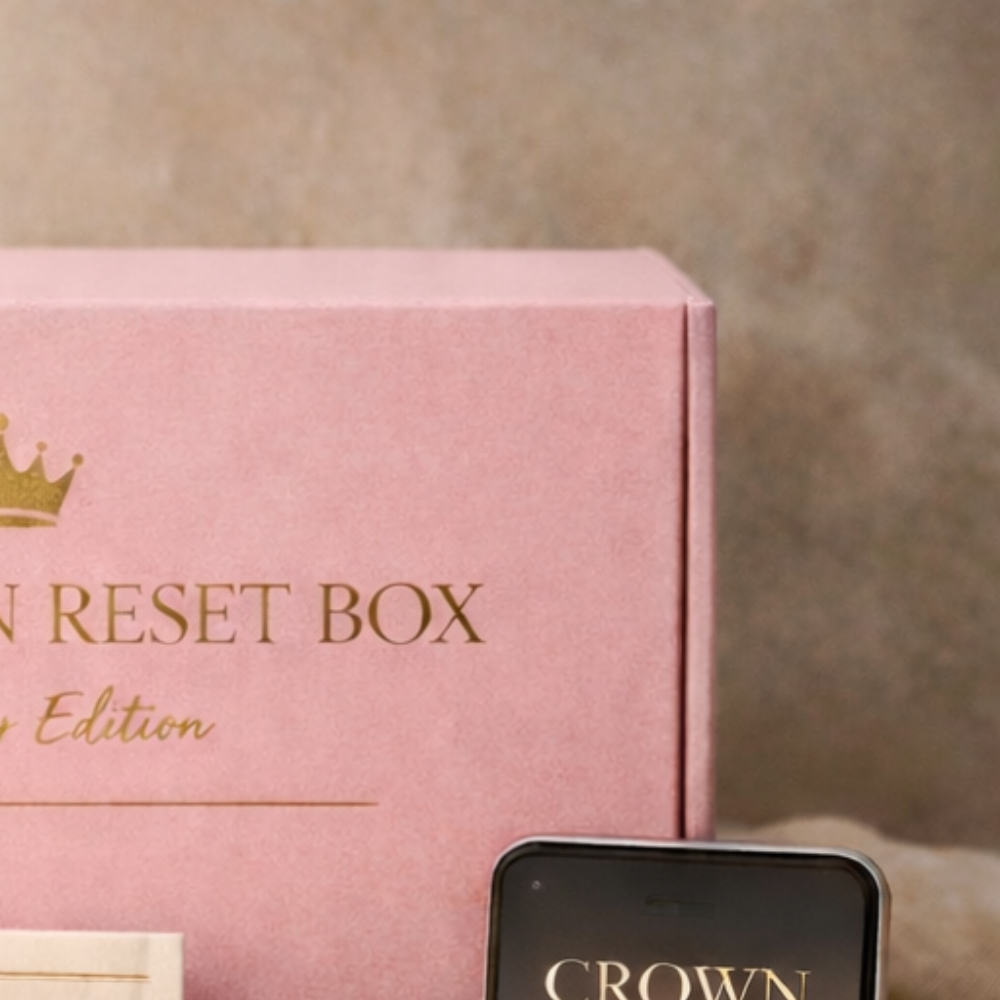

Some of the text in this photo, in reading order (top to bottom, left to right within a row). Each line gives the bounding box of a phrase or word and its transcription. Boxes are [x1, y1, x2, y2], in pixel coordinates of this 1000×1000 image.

[47, 582, 292, 645] RESET
[317, 582, 488, 646] BOX
[34, 685, 217, 745] Edition
